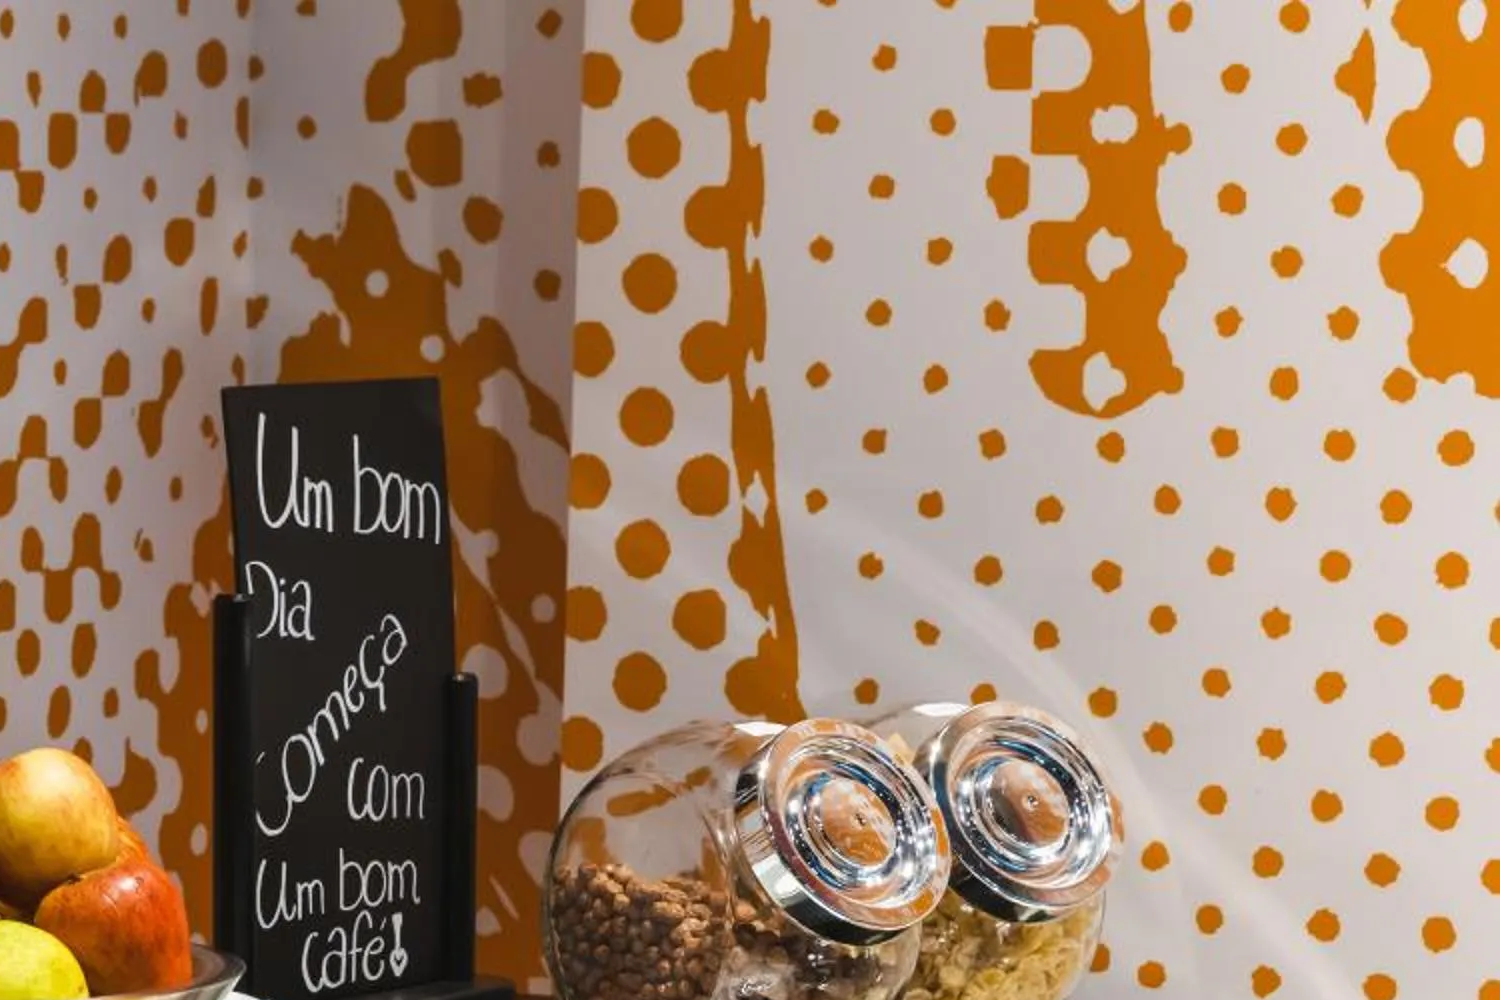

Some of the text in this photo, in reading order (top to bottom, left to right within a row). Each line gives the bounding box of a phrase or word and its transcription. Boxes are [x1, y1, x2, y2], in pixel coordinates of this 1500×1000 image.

[256, 411, 442, 545] Um bom
[245, 559, 316, 642] Dia
[255, 847, 422, 930] Um bom
